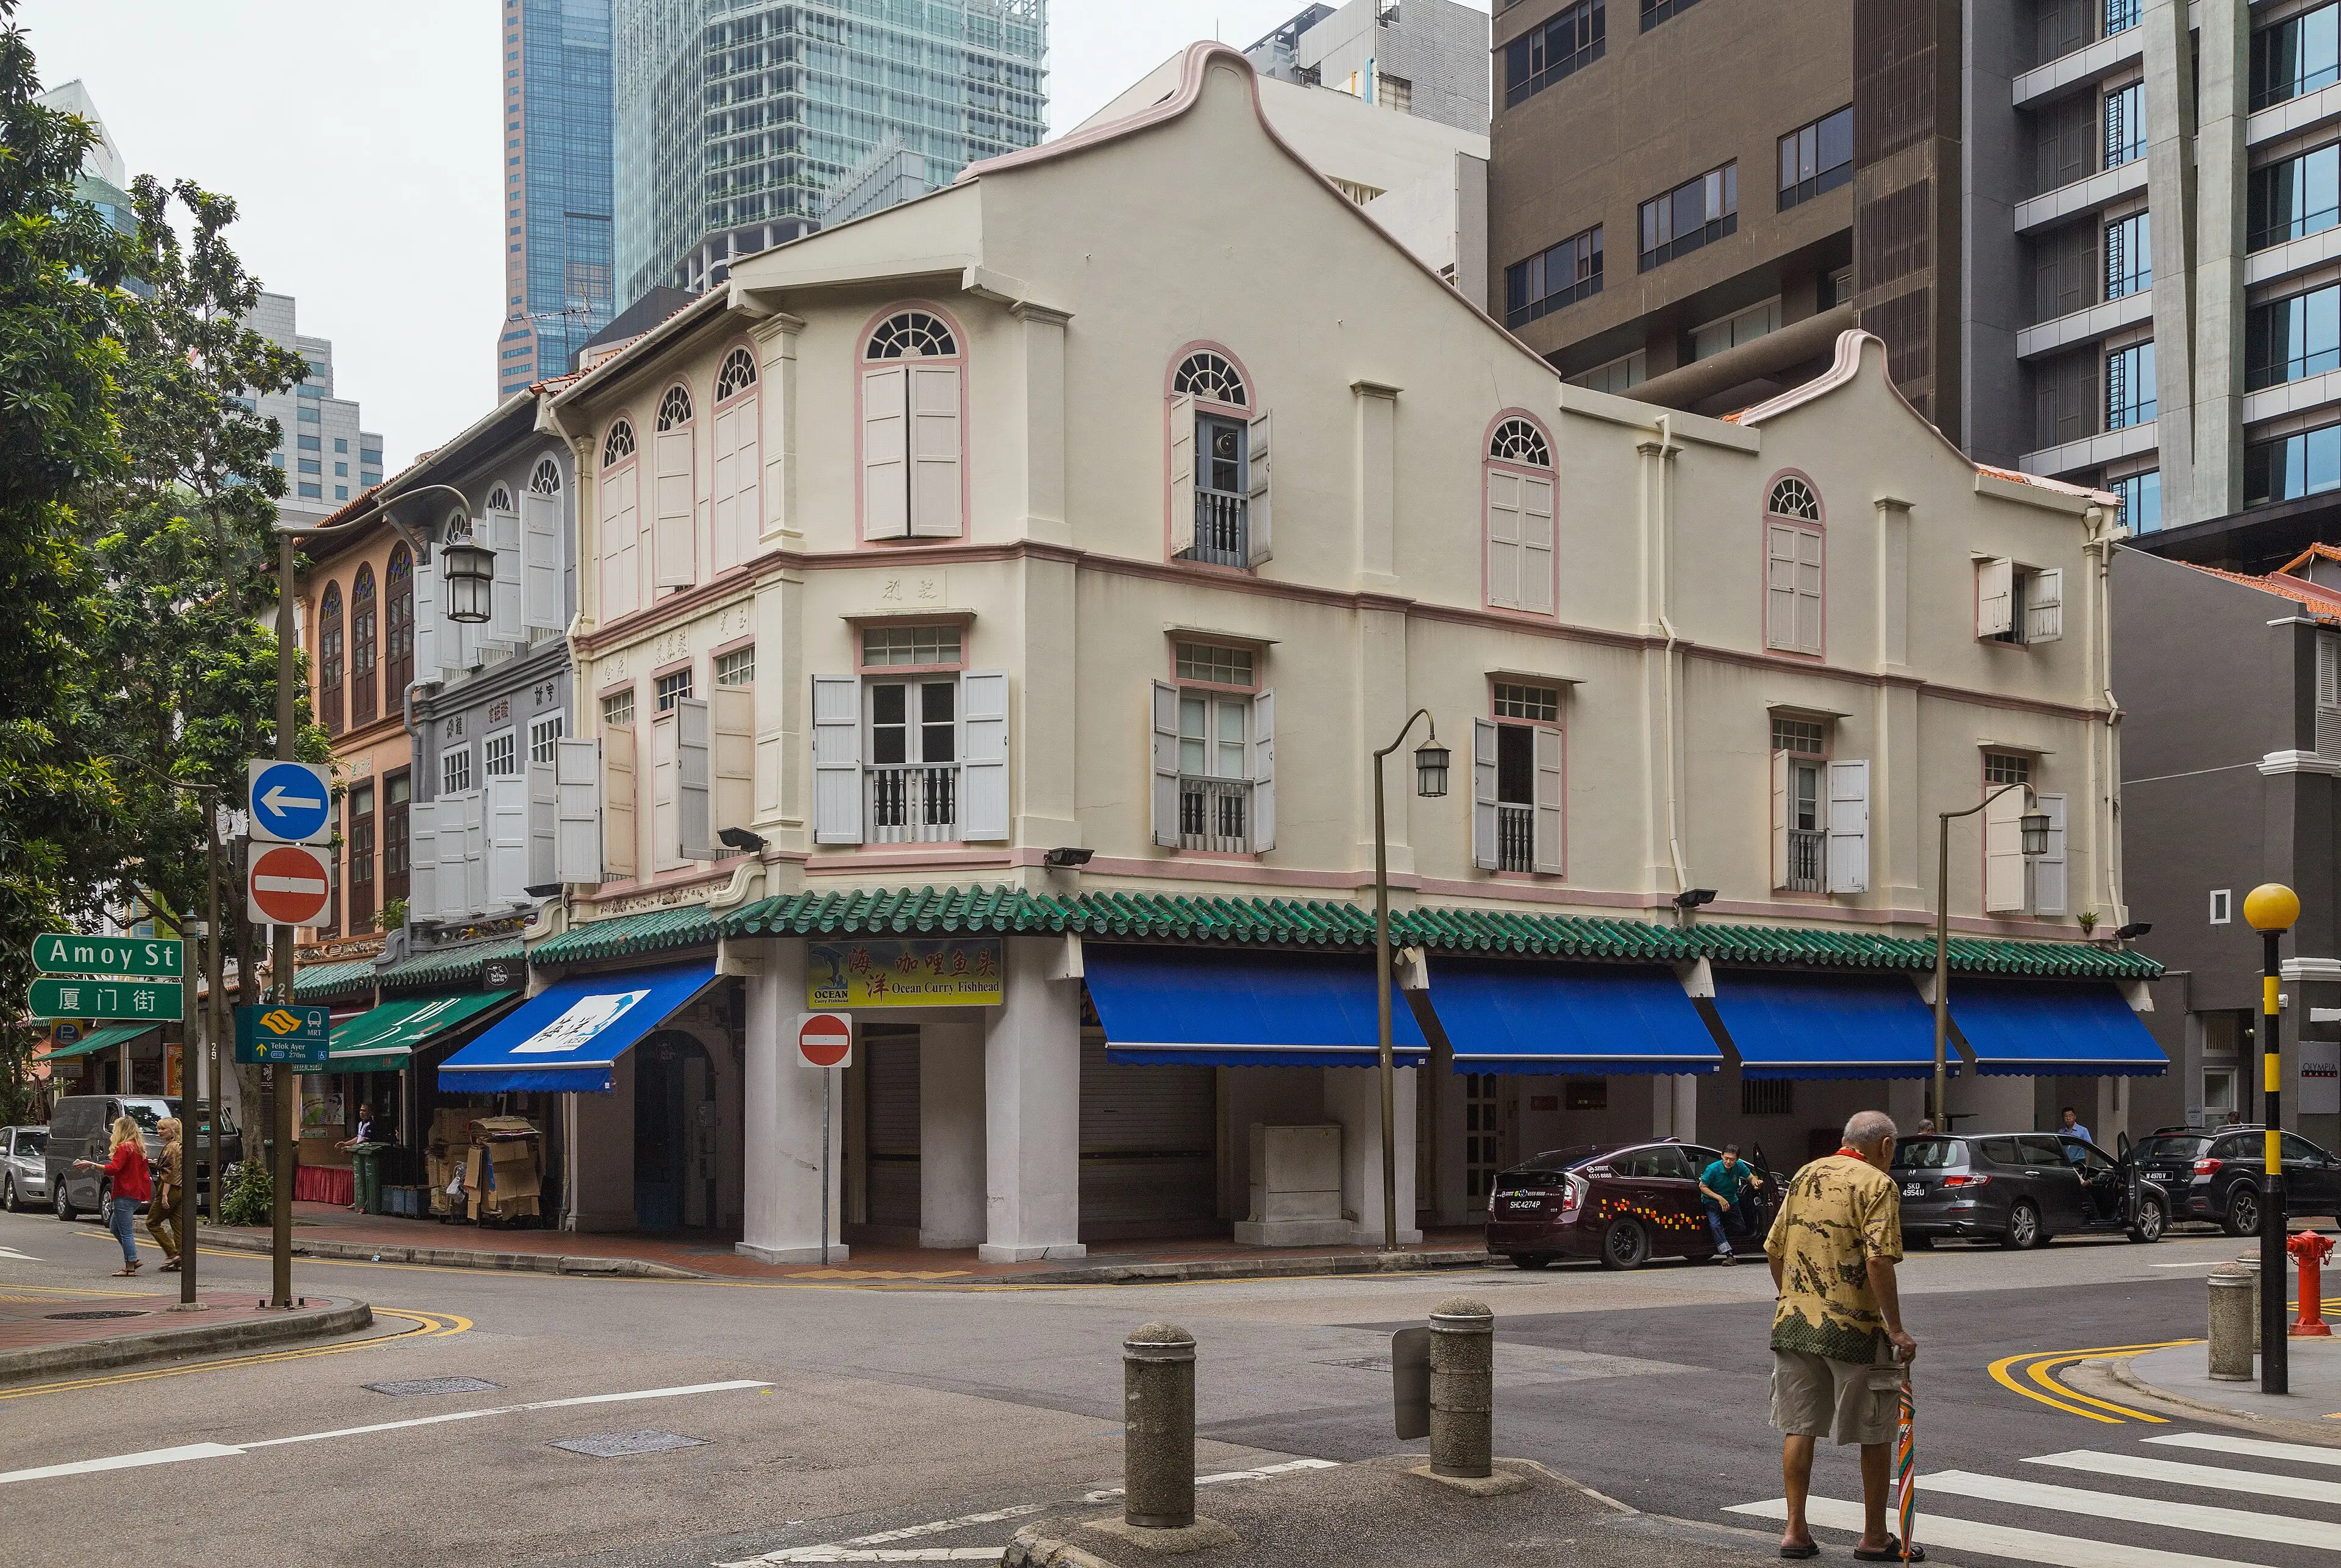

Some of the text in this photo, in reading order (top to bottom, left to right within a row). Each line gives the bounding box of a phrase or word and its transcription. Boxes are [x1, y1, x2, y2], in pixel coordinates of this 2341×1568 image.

[49, 939, 174, 970] Amoy St
[891, 980, 1000, 996] Ocean Curry Fishhead
[58, 988, 155, 1012] 厦门街
[211, 1042, 216, 1060] 29
[290, 1043, 306, 1052] Ayer
[1381, 1053, 1386, 1063] 1
[2303, 1063, 2336, 1071] OLYMPIA
[1509, 1200, 1541, 1209] SHC4274P
